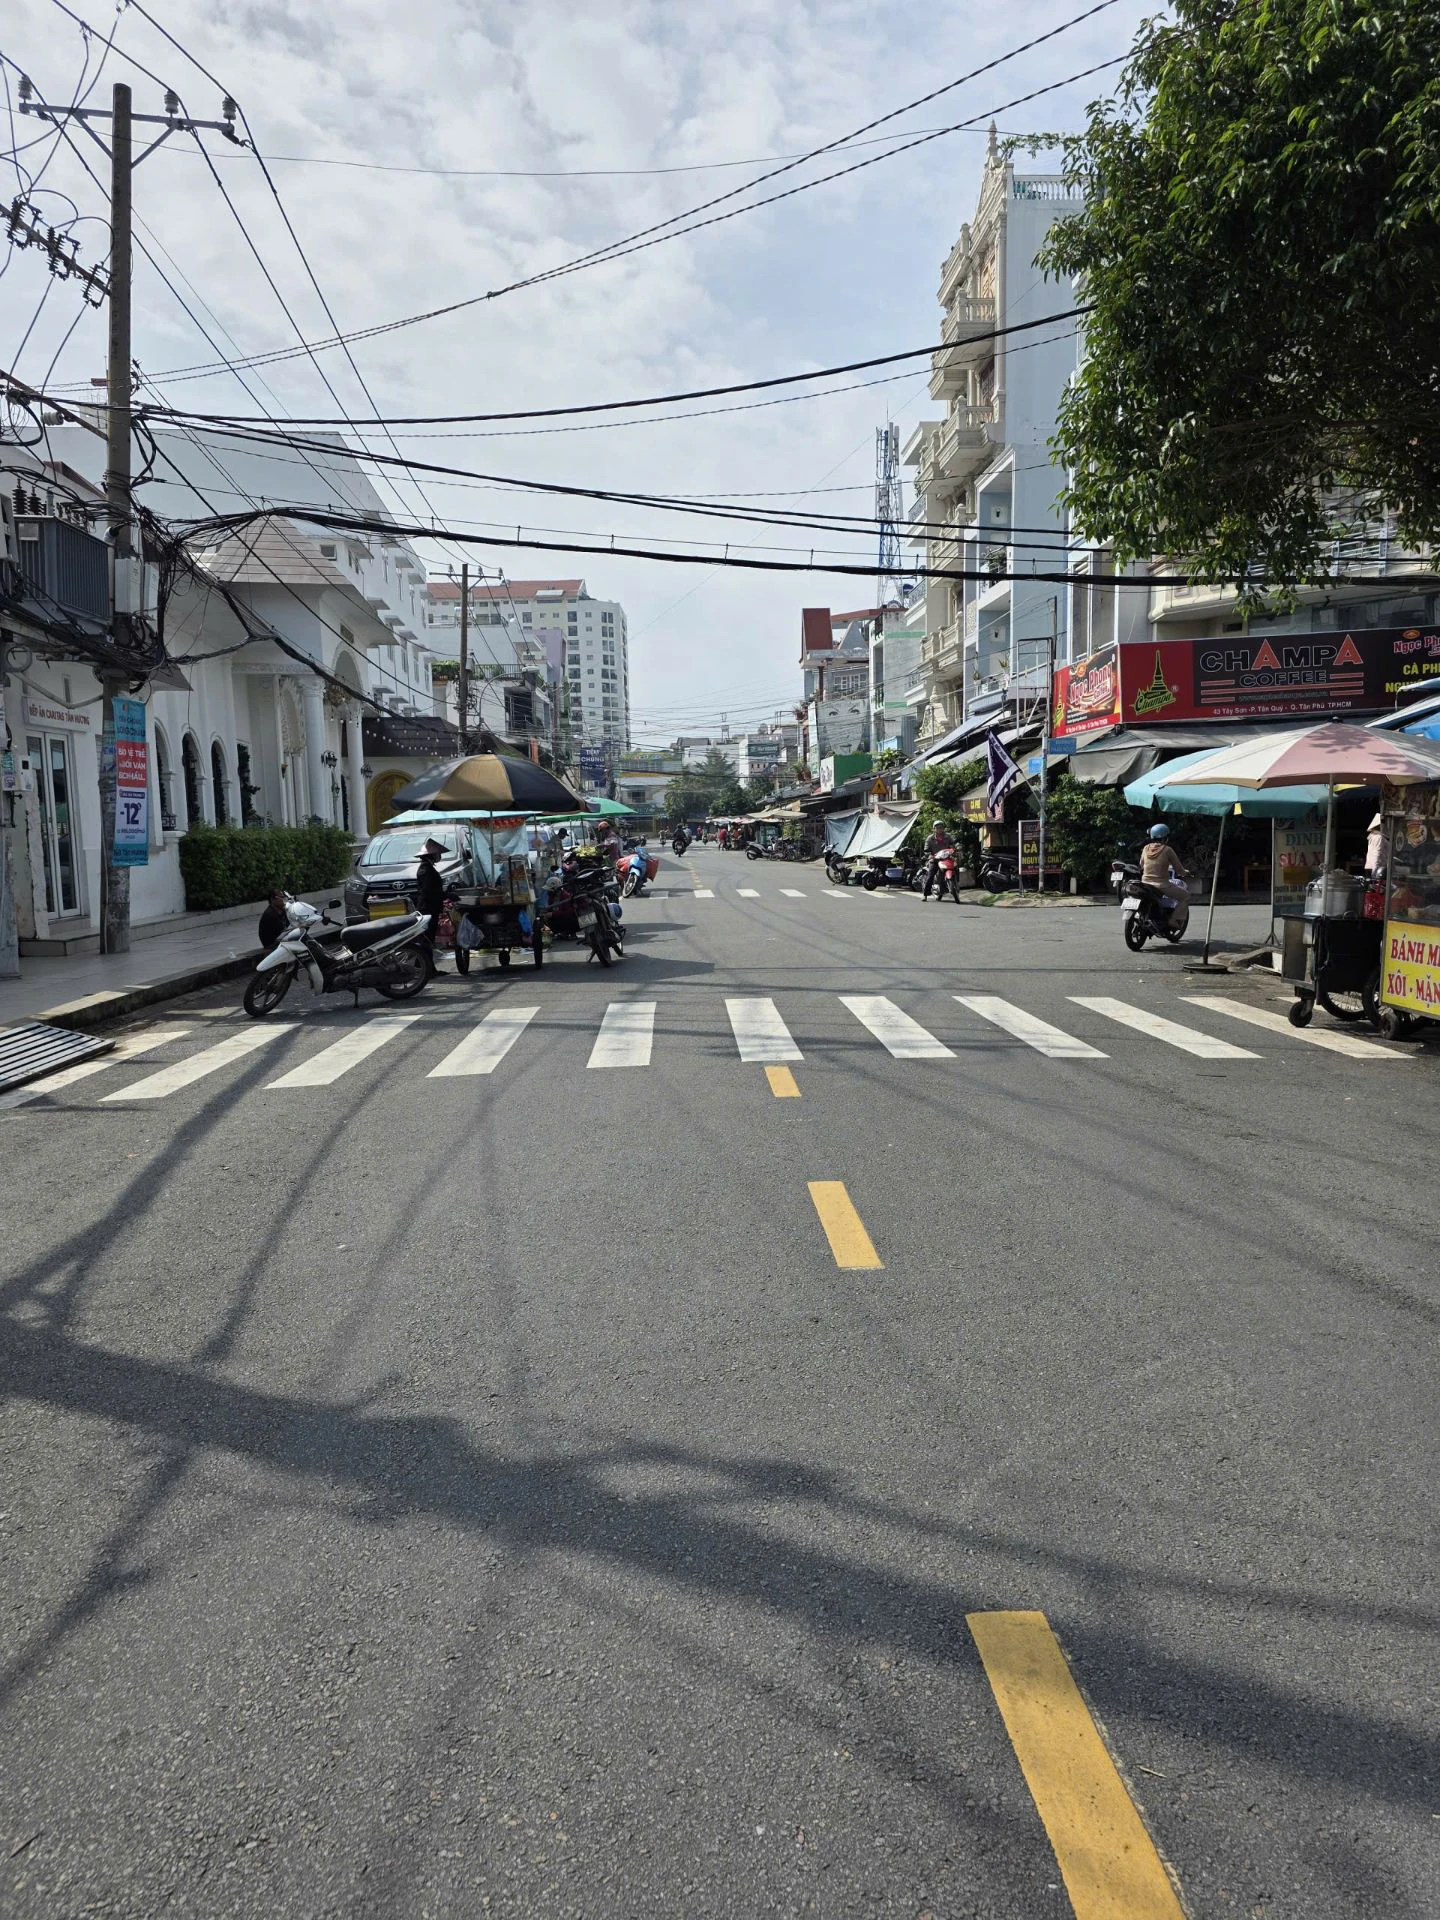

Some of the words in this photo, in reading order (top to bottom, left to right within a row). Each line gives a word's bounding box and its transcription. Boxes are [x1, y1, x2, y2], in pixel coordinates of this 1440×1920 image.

[1200, 634, 1364, 673] CHAMPA
[1393, 640, 1422, 655] Ngọc
[1424, 635, 1440, 648] Ph
[1403, 662, 1418, 675] CÀ
[1240, 669, 1327, 688] COFFEE
[1257, 704, 1269, 713] Tân
[1299, 702, 1311, 711] Tân
[1024, 841, 1038, 854] CÀ
[1391, 933, 1426, 964] BÁNH
[1387, 969, 1407, 996] XÔI
